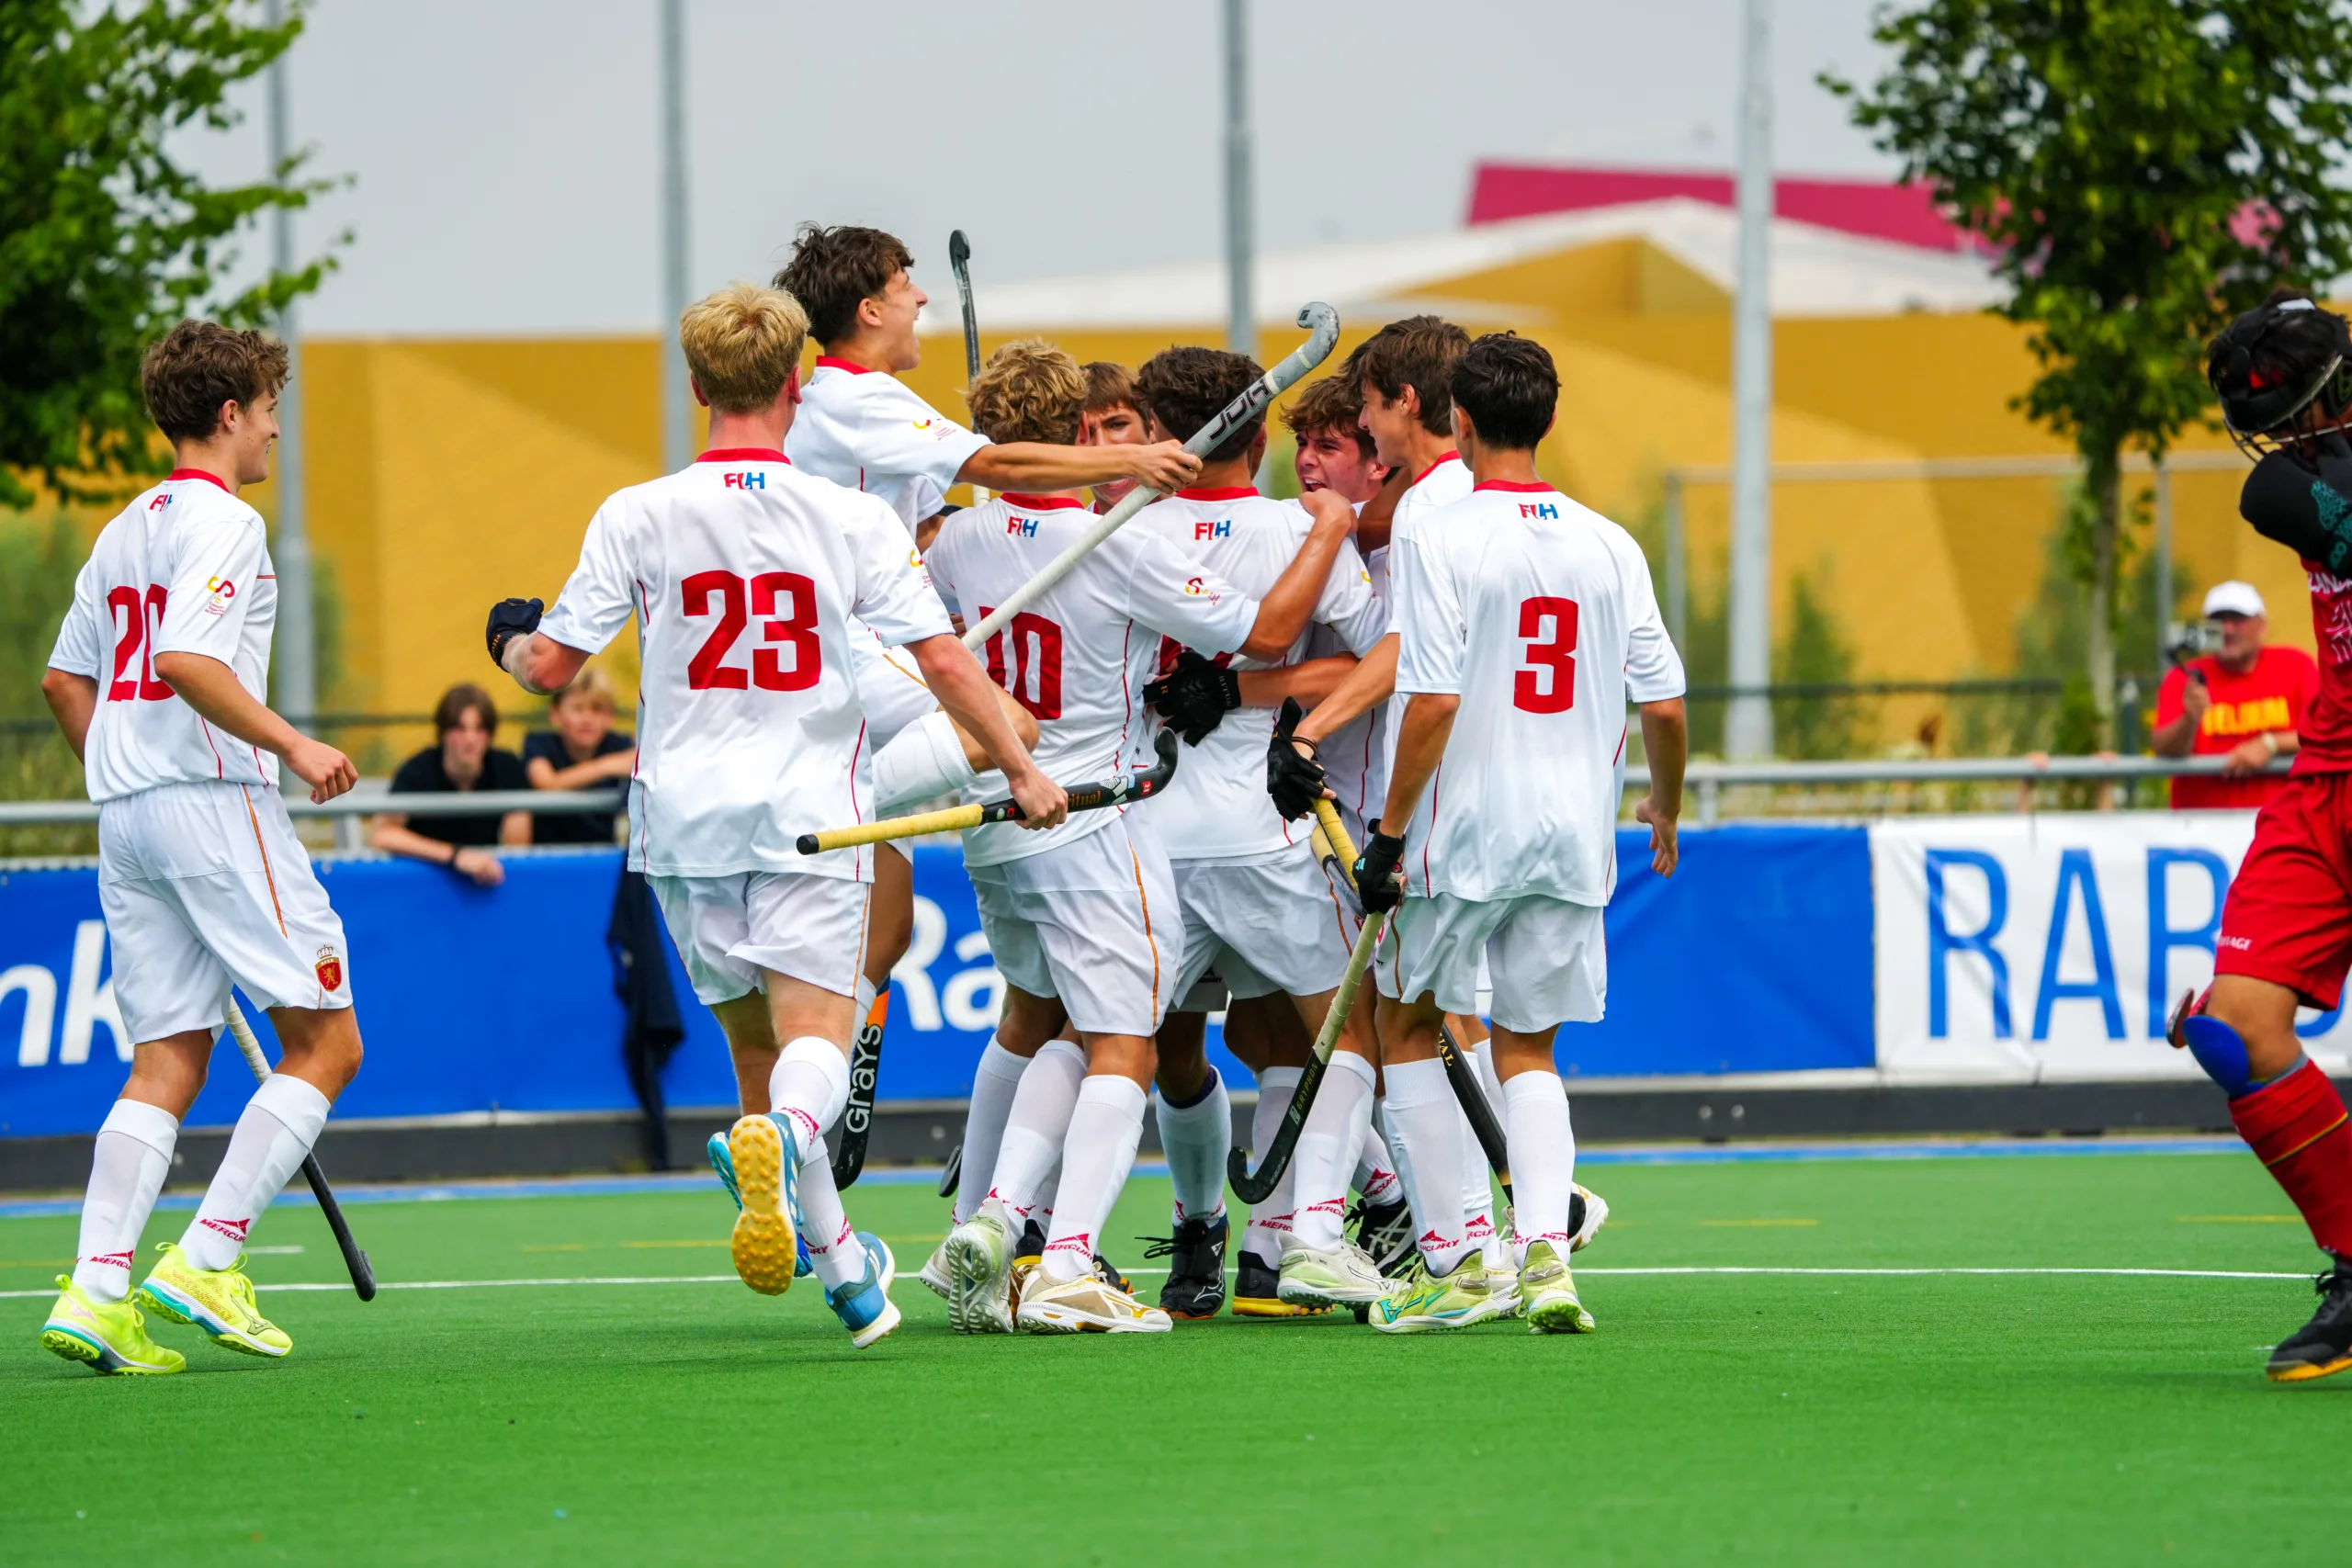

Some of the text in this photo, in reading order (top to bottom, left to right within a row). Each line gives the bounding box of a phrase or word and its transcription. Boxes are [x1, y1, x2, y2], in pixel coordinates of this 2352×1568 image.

[1208, 378, 1272, 441] JDH
[723, 471, 765, 491] FIH
[1007, 515, 1039, 538] FIH
[1194, 520, 1231, 541] FIH
[1518, 502, 1559, 521] FIH
[107, 582, 177, 703] 20
[681, 570, 821, 692] 23
[1513, 595, 1578, 715] 3
[1926, 847, 2346, 1041] RAB
[1296, 1061, 1318, 1111] GRYPHON
